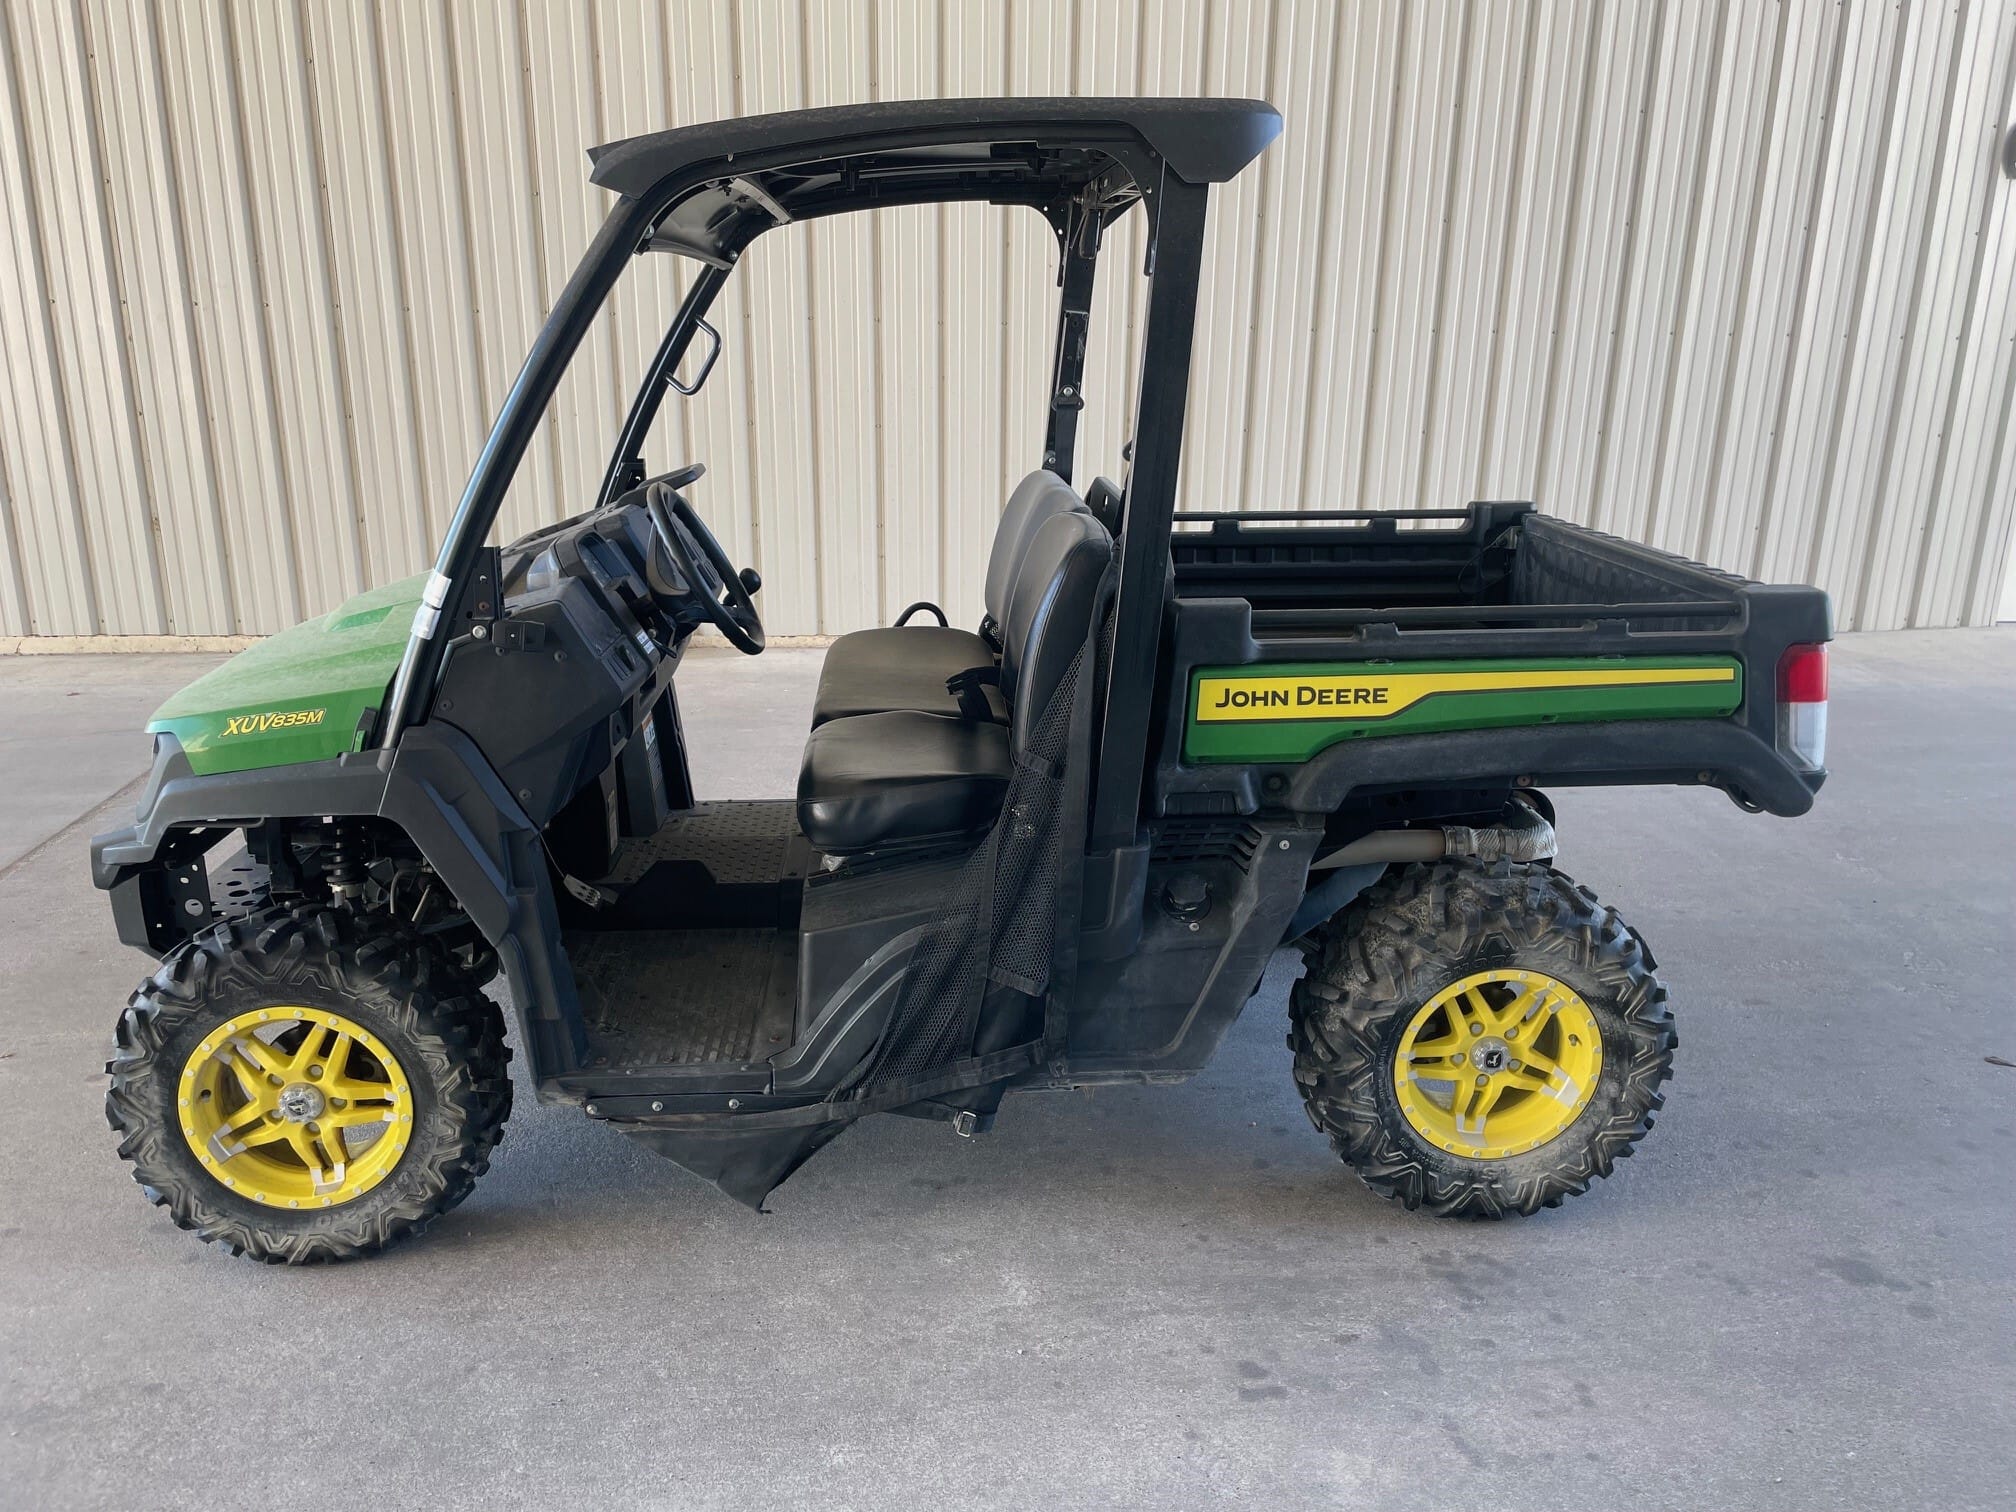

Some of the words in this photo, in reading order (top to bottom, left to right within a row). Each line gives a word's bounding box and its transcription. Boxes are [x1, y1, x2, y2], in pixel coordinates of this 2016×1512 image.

[1215, 688, 1289, 708] JOHN
[1296, 686, 1388, 706] DEERE
[220, 709, 325, 737] XUV835M
